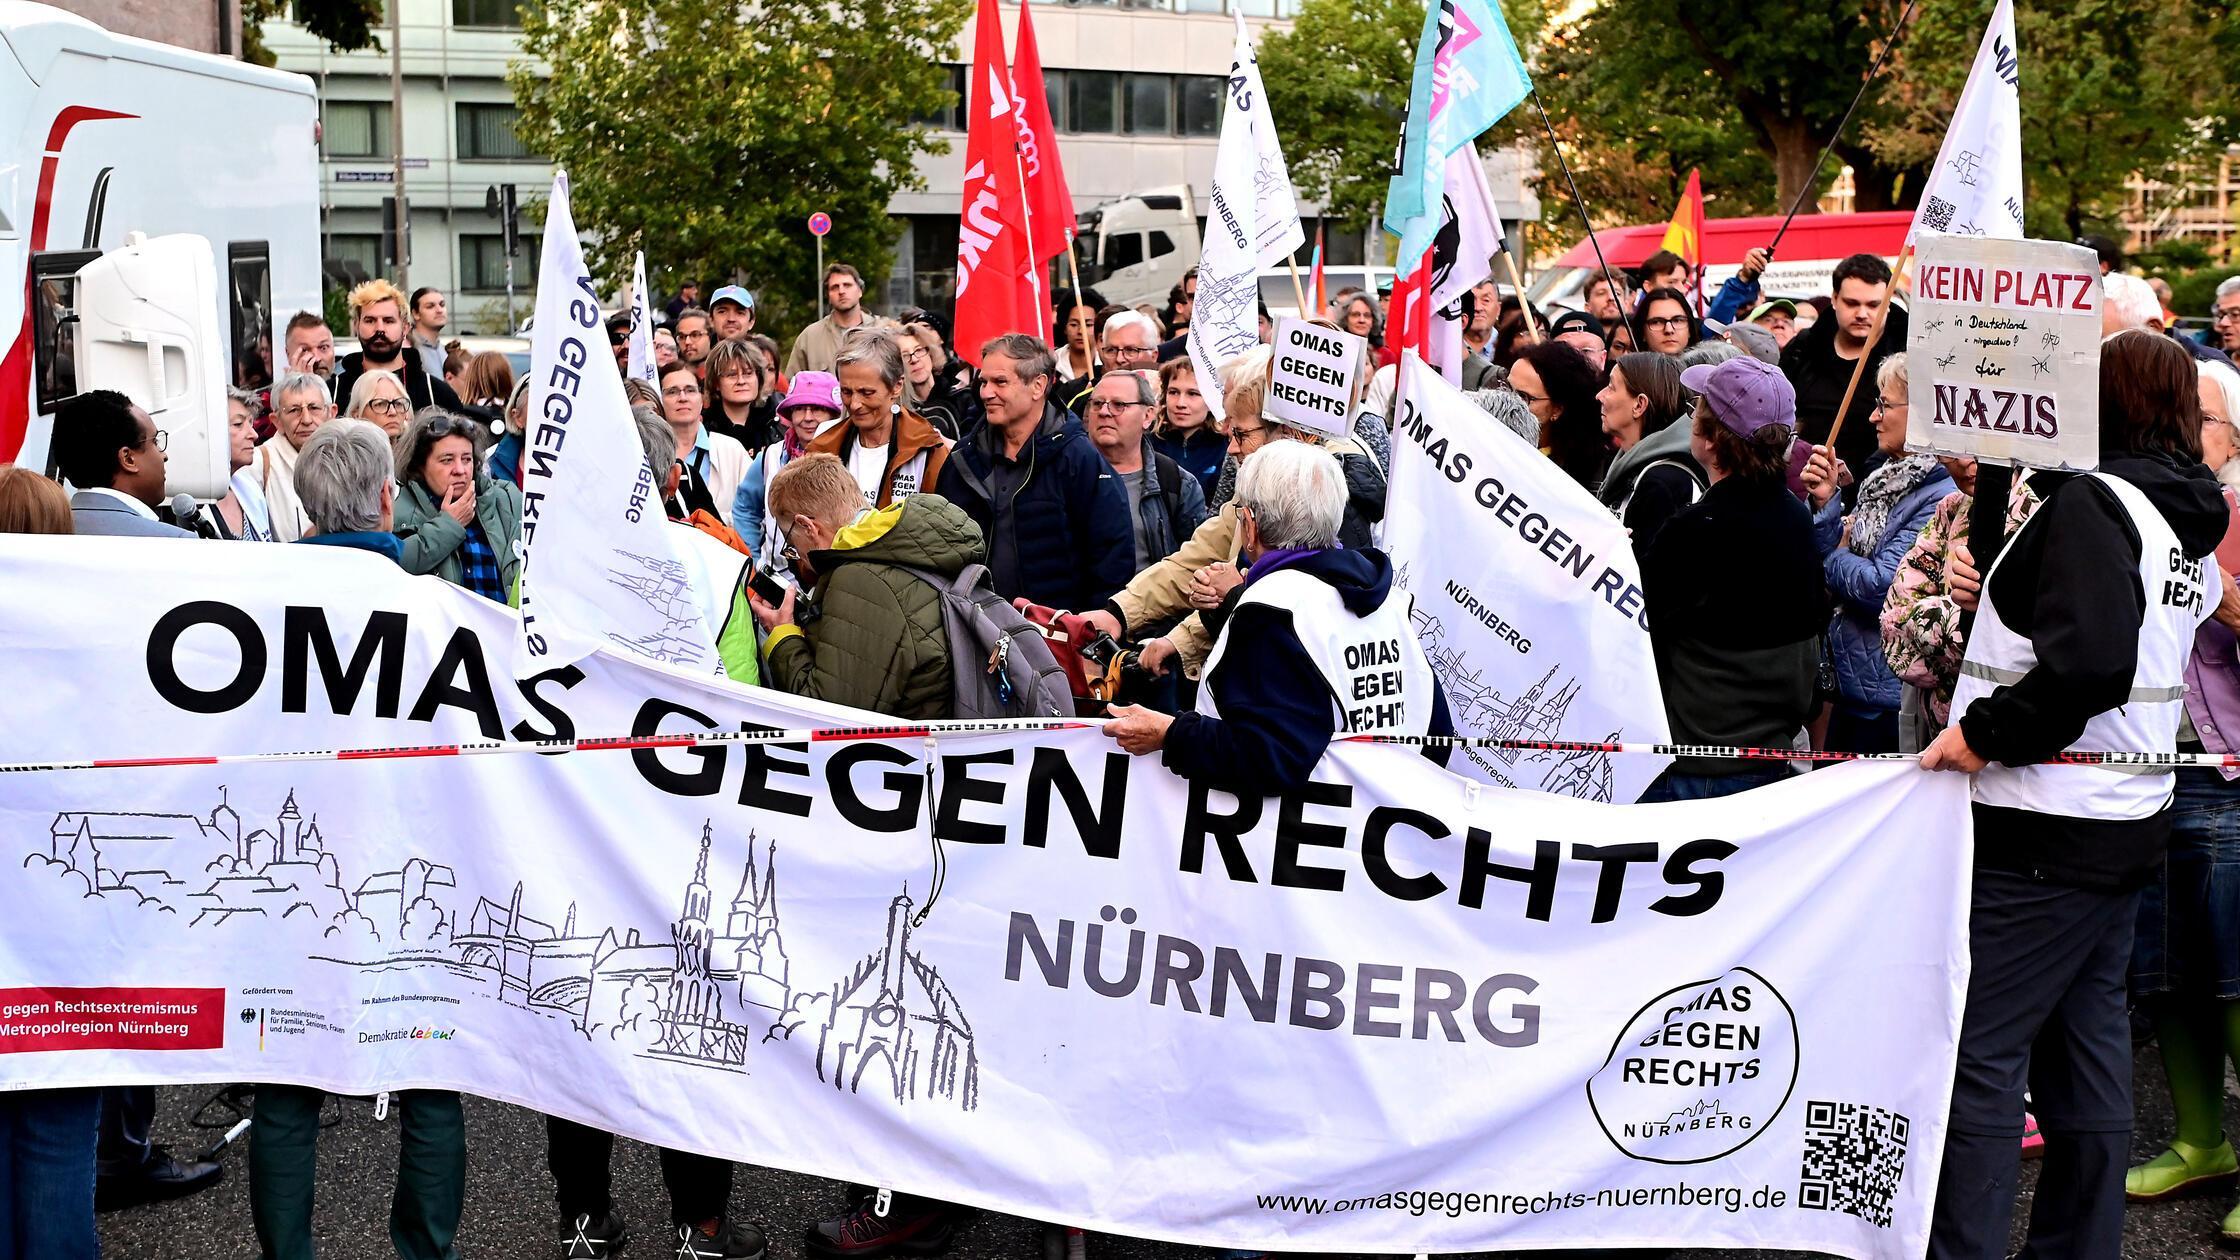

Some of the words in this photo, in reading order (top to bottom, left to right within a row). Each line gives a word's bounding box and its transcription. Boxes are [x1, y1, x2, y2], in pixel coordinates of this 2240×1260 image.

[1919, 264, 1984, 303] KEIN
[1994, 269, 2093, 311] PLATZ
[1954, 315, 1963, 327] in
[1969, 315, 2028, 330] Deutschland
[1290, 330, 1344, 357] OMAS
[1280, 356, 1345, 388] GEGEN
[1975, 356, 2006, 378] für
[1273, 381, 1345, 417] RECHTS
[1933, 384, 2059, 439] NAZIS
[1474, 477, 1596, 579] GEGEN
[1444, 577, 1533, 656] NÜRNBERG
[1344, 639, 1400, 670] OMAS
[1350, 670, 1403, 701] EGEN
[147, 600, 587, 756] OMAS
[630, 697, 1130, 860] GEGEN
[1179, 775, 1739, 925] RECHTS
[1003, 904, 1542, 1049] NÜRNBERG
[3, 1003, 50, 1018] gegen
[54, 1000, 198, 1015] Rechtsextremismus
[270, 1008, 325, 1020] Bundesministerium
[400, 994, 460, 1004] Bundesprogramms
[1663, 985, 1752, 1025] OMAS
[0, 1020, 114, 1037] Metropolregion
[118, 1021, 189, 1036] Nürnberg
[358, 1029, 408, 1043] Demokratie
[1639, 1022, 1761, 1051] GEGEN
[1622, 1057, 1761, 1087] RECHTS
[1624, 1115, 1752, 1139] NÜRNBERG
[1256, 1182, 1786, 1218] www.omasgegenrechts-nuernberg.de
